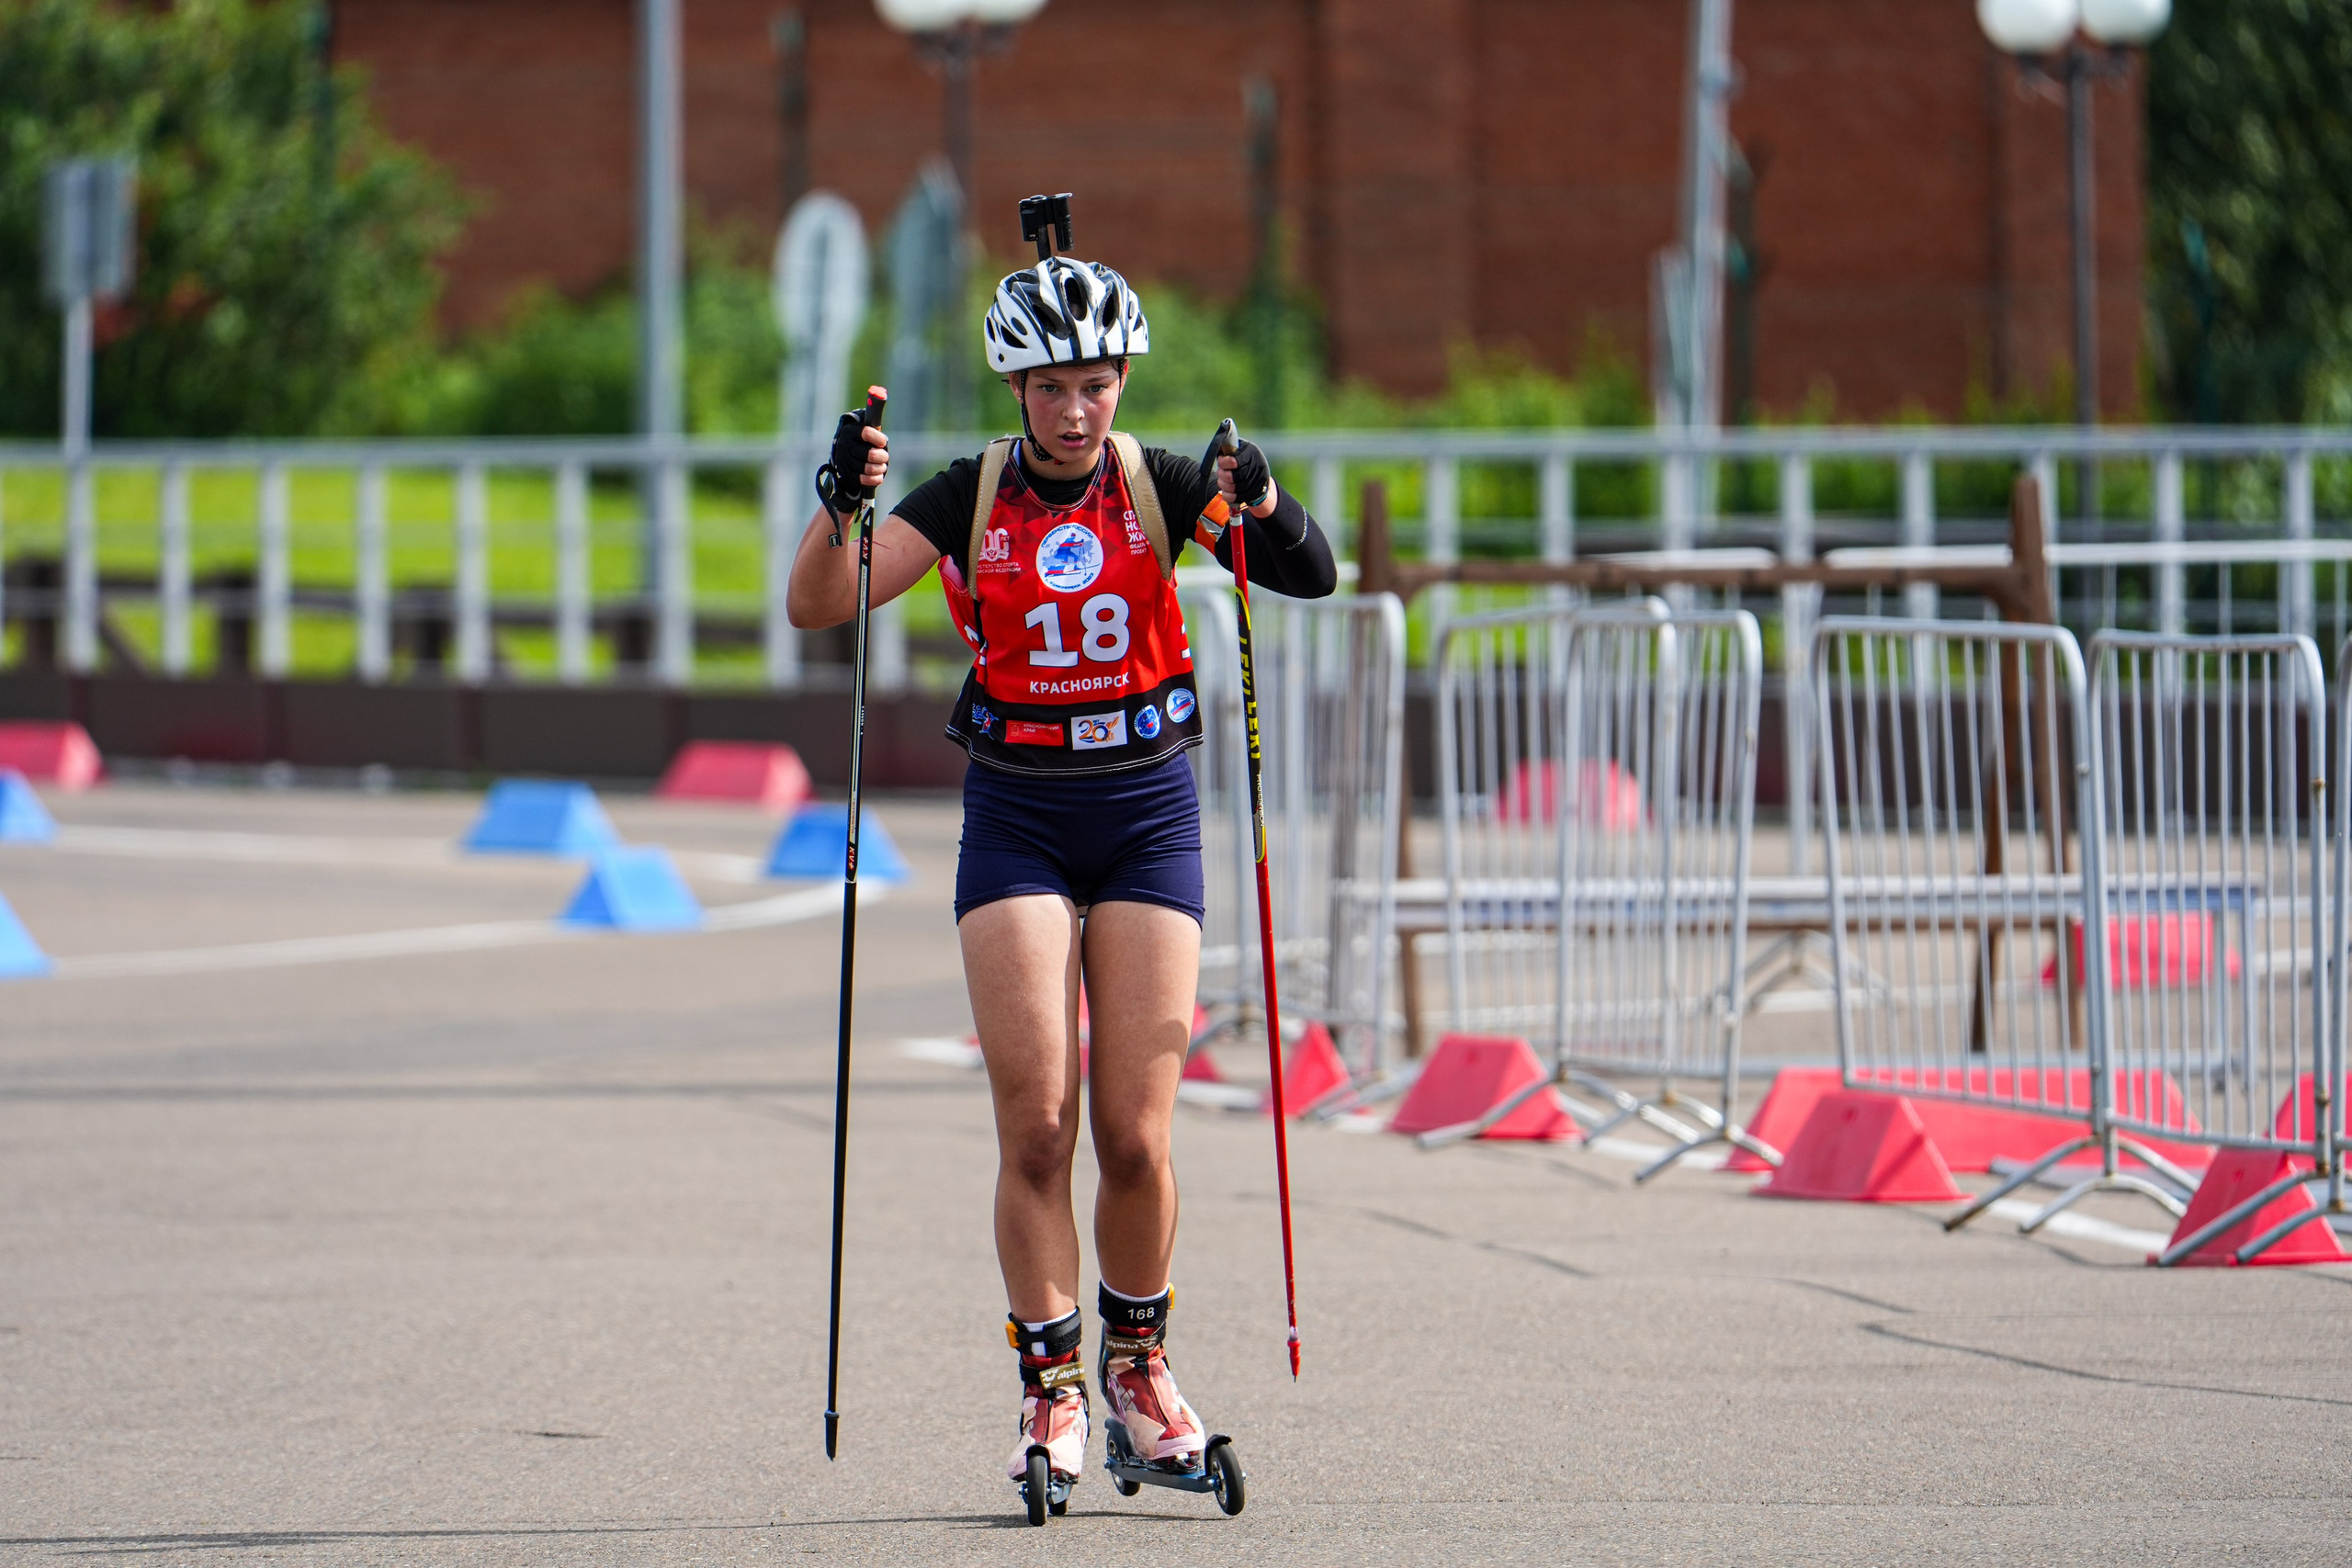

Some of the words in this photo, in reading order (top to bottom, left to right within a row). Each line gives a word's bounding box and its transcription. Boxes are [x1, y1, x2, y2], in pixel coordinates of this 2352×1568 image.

[862, 536, 870, 559] KV+
[1024, 593, 1130, 668] 18
[1030, 671, 1130, 694] КРАСНОЯРСК
[1247, 701, 1261, 759] LEKI
[1127, 1306, 1155, 1320] 168
